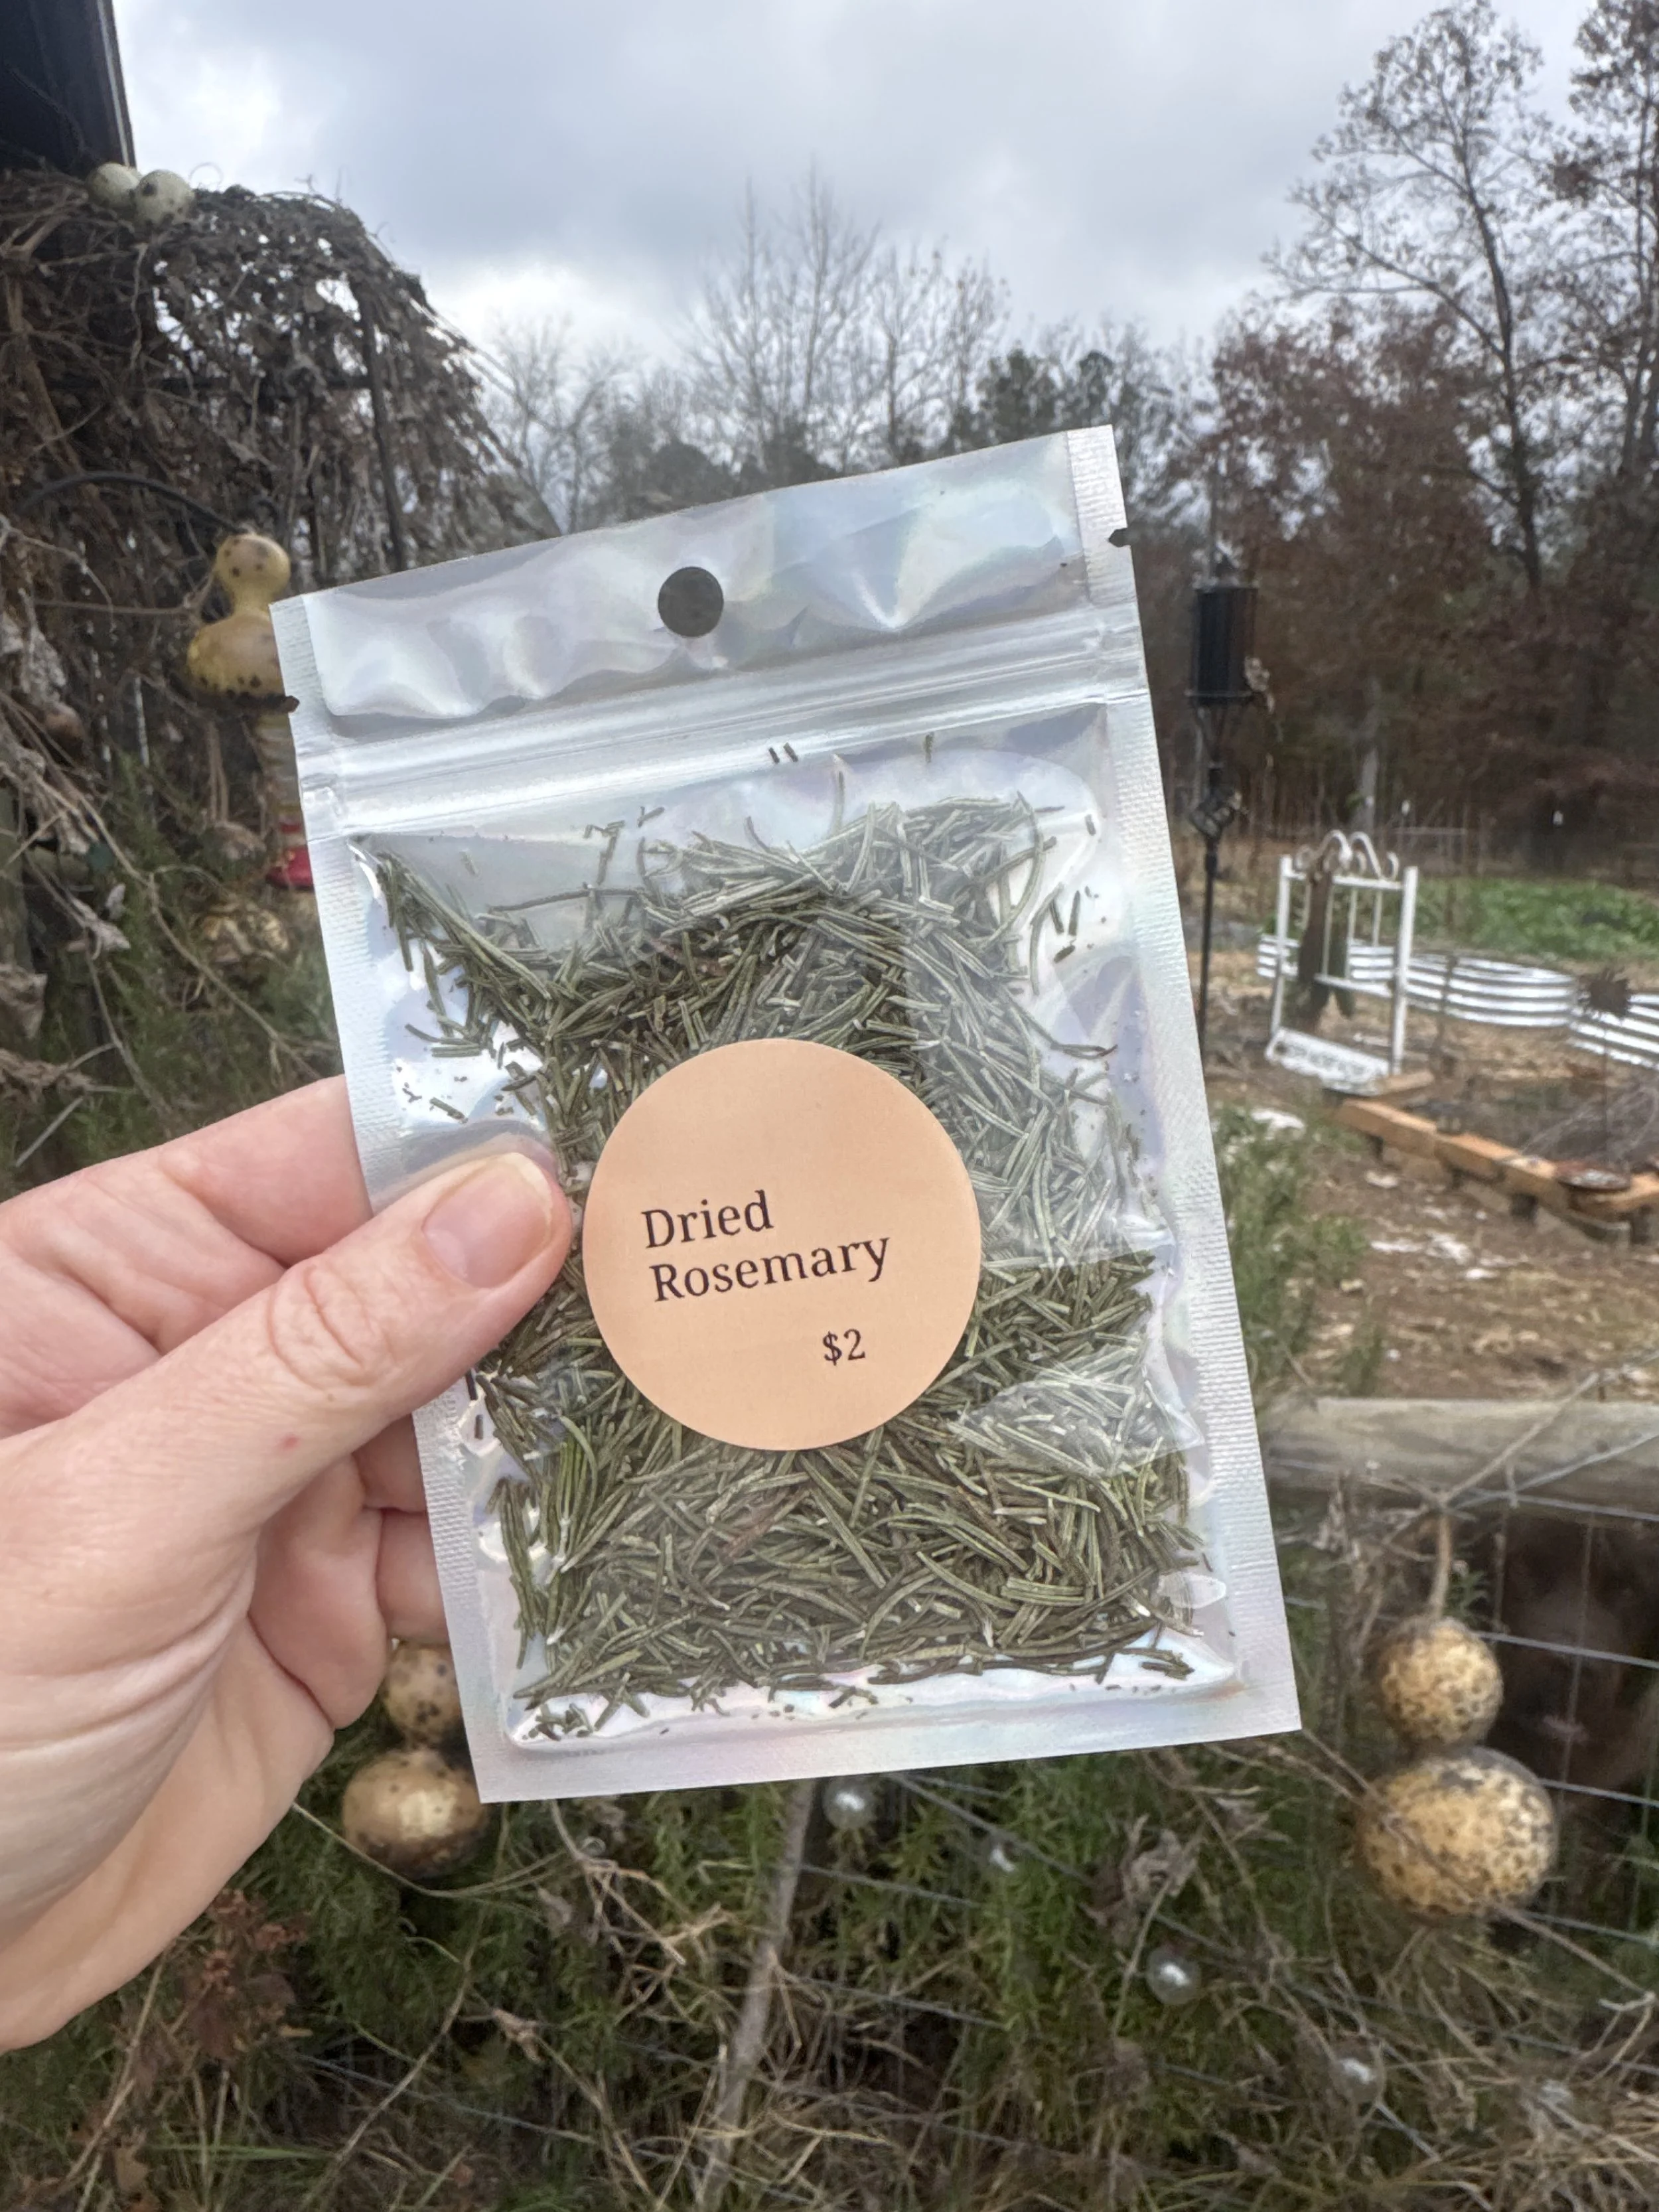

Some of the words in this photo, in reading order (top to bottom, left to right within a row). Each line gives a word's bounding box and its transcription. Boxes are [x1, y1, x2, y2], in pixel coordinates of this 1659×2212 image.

[641, 1189, 774, 1248] Dried
[649, 1238, 890, 1301] Rosemary
[823, 1329, 866, 1366] $2
